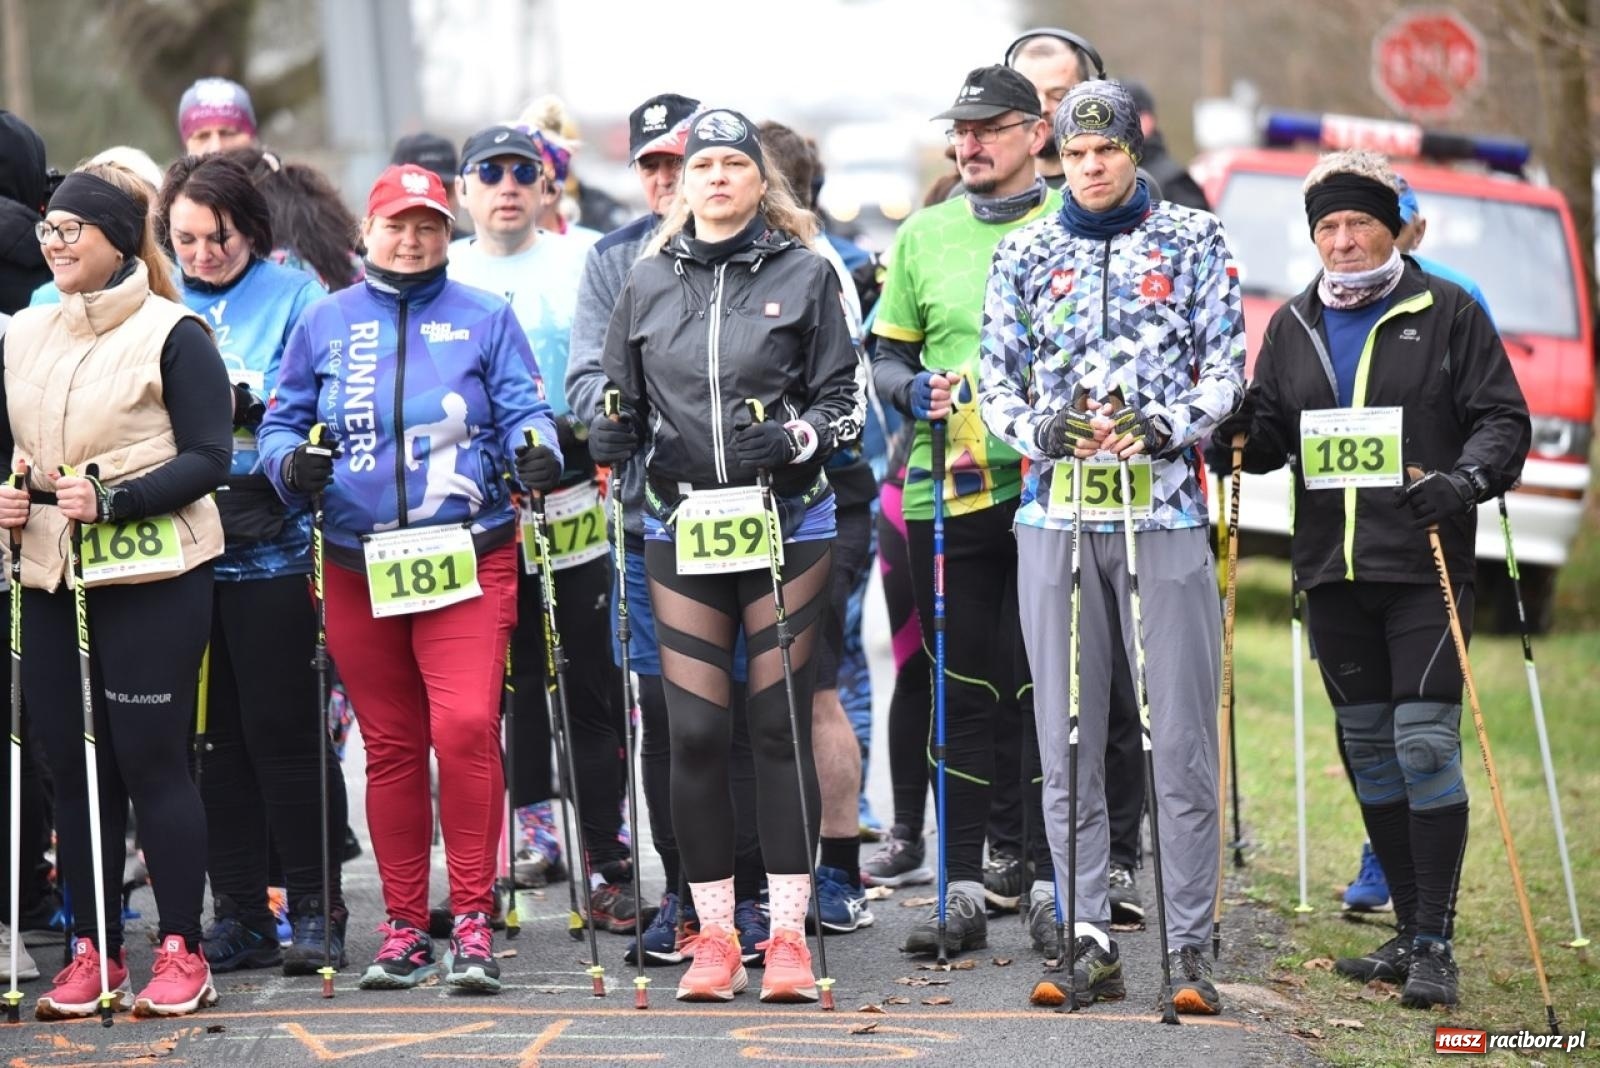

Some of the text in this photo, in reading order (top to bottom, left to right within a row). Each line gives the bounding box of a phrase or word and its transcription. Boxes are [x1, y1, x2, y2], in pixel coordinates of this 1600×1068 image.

[344, 320, 380, 473] RUNNERS
[1316, 437, 1385, 473] 183
[1064, 468, 1136, 505] 158
[1229, 464, 1242, 538] VIKING
[83, 521, 163, 565] 168
[546, 512, 599, 554] 172
[690, 517, 763, 558] 159
[385, 554, 461, 598] 181
[77, 583, 90, 644] FIZAN
[84, 678, 92, 713] CARBON
[118, 693, 171, 704] GLAMOUR
